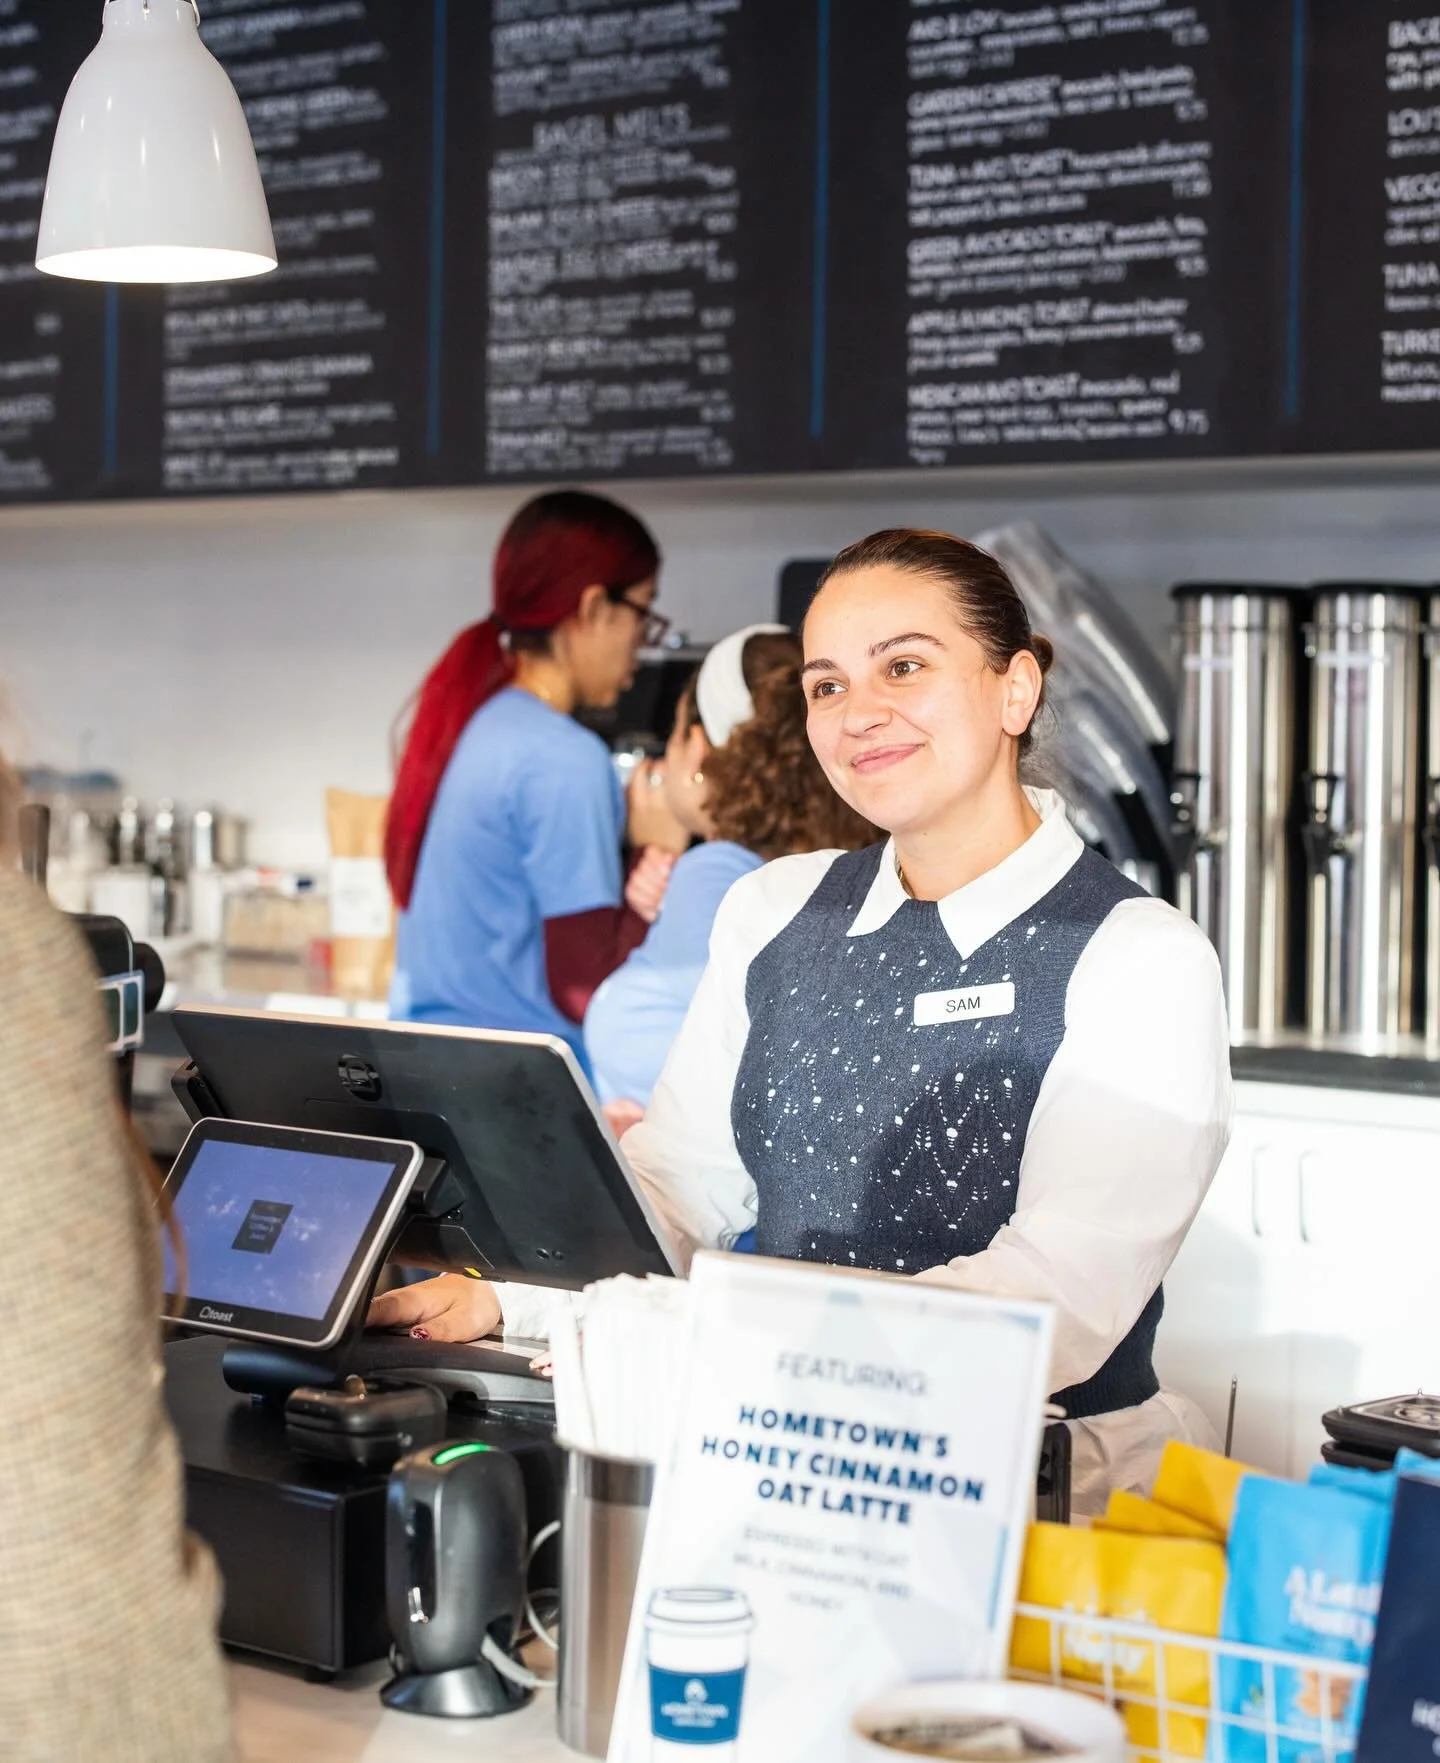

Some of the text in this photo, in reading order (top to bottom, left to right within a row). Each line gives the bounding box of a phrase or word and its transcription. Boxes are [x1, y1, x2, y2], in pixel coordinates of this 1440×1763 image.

[945, 996, 981, 1013] SAM
[210, 1309, 234, 1323] toast
[775, 1352, 930, 1397] FEATURING
[738, 1404, 949, 1459] HOMETOWN'S
[701, 1434, 986, 1502] HONEY CINNAMON
[757, 1479, 912, 1525] OAT LATTE
